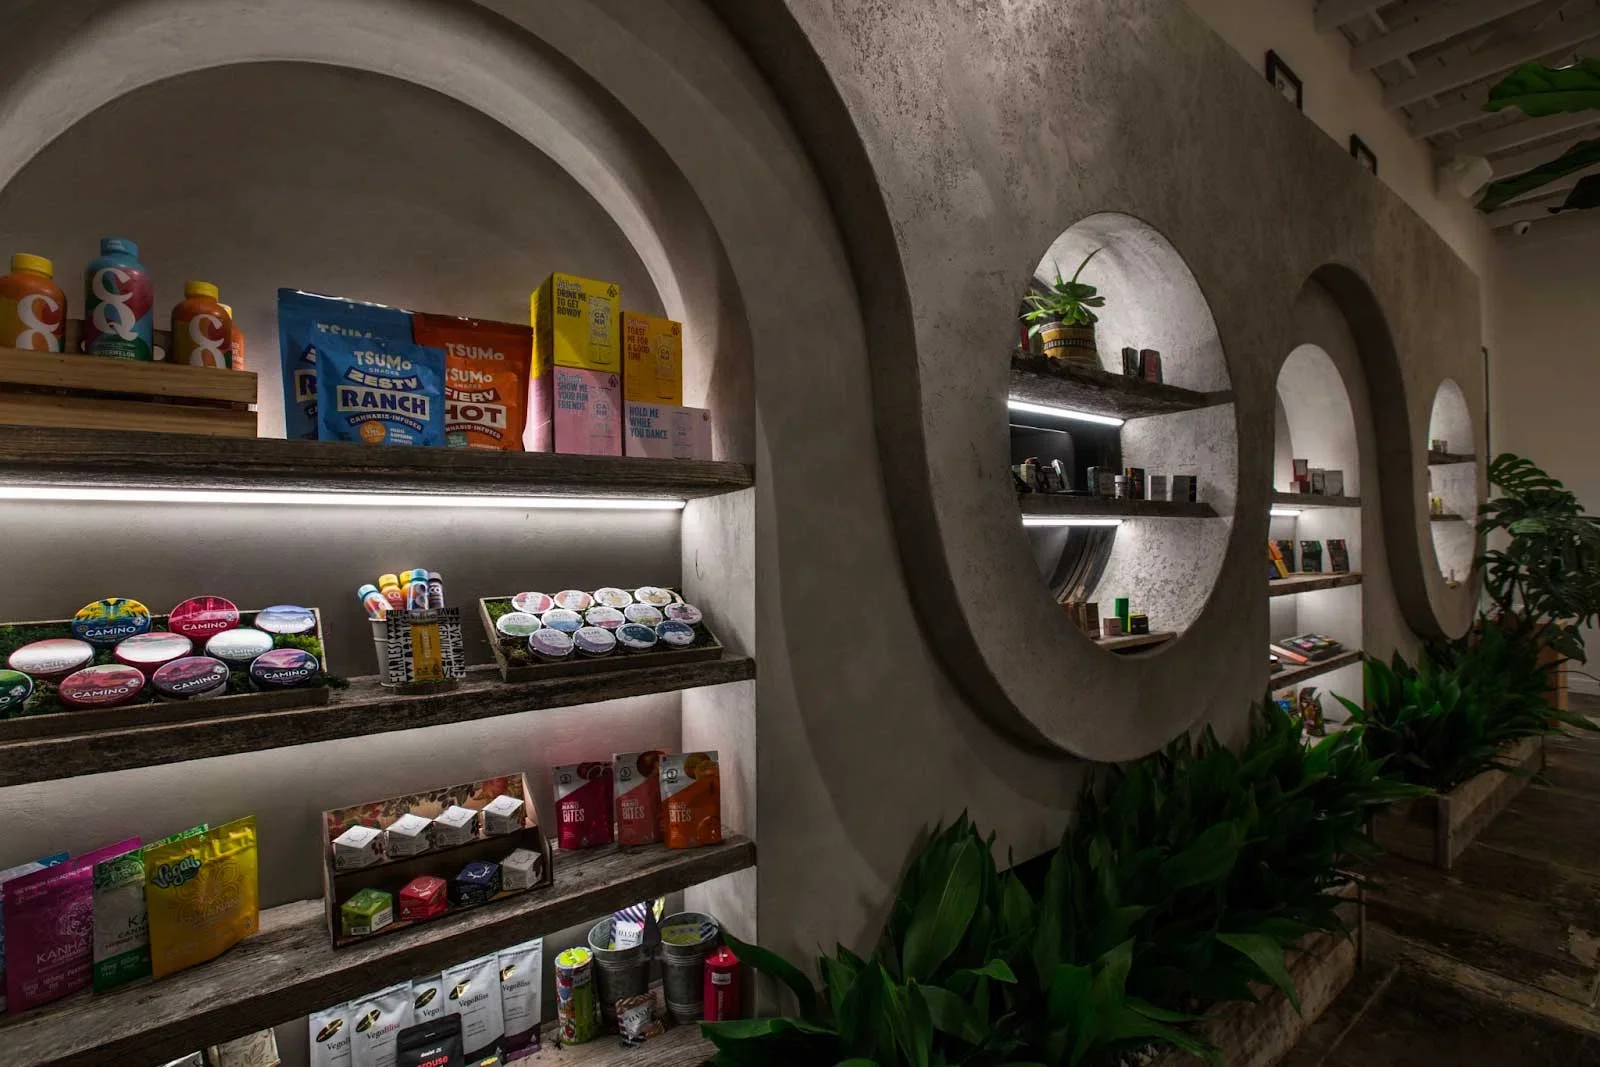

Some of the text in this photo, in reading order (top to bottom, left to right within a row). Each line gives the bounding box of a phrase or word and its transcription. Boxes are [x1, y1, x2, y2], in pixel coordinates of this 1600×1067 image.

[348, 370, 418, 390] ZESTY
[342, 389, 426, 416] RANCH
[630, 407, 660, 419] HOLD ME
[631, 427, 645, 440] YOU
[86, 626, 136, 638] CAMINO
[182, 621, 228, 631] CAMINO
[263, 669, 308, 679] CAMINO
[172, 675, 221, 691] CAMINO
[72, 687, 129, 699] CAMINO
[563, 808, 585, 823] BITES
[622, 806, 645, 821] BITES
[669, 808, 692, 823] BITES
[152, 855, 200, 889] Vegan
[37, 939, 89, 964] KANHA
[502, 981, 530, 992] VegoBliss
[458, 992, 489, 1008] VegoBliss
[366, 1023, 400, 1039] VegoBliss
